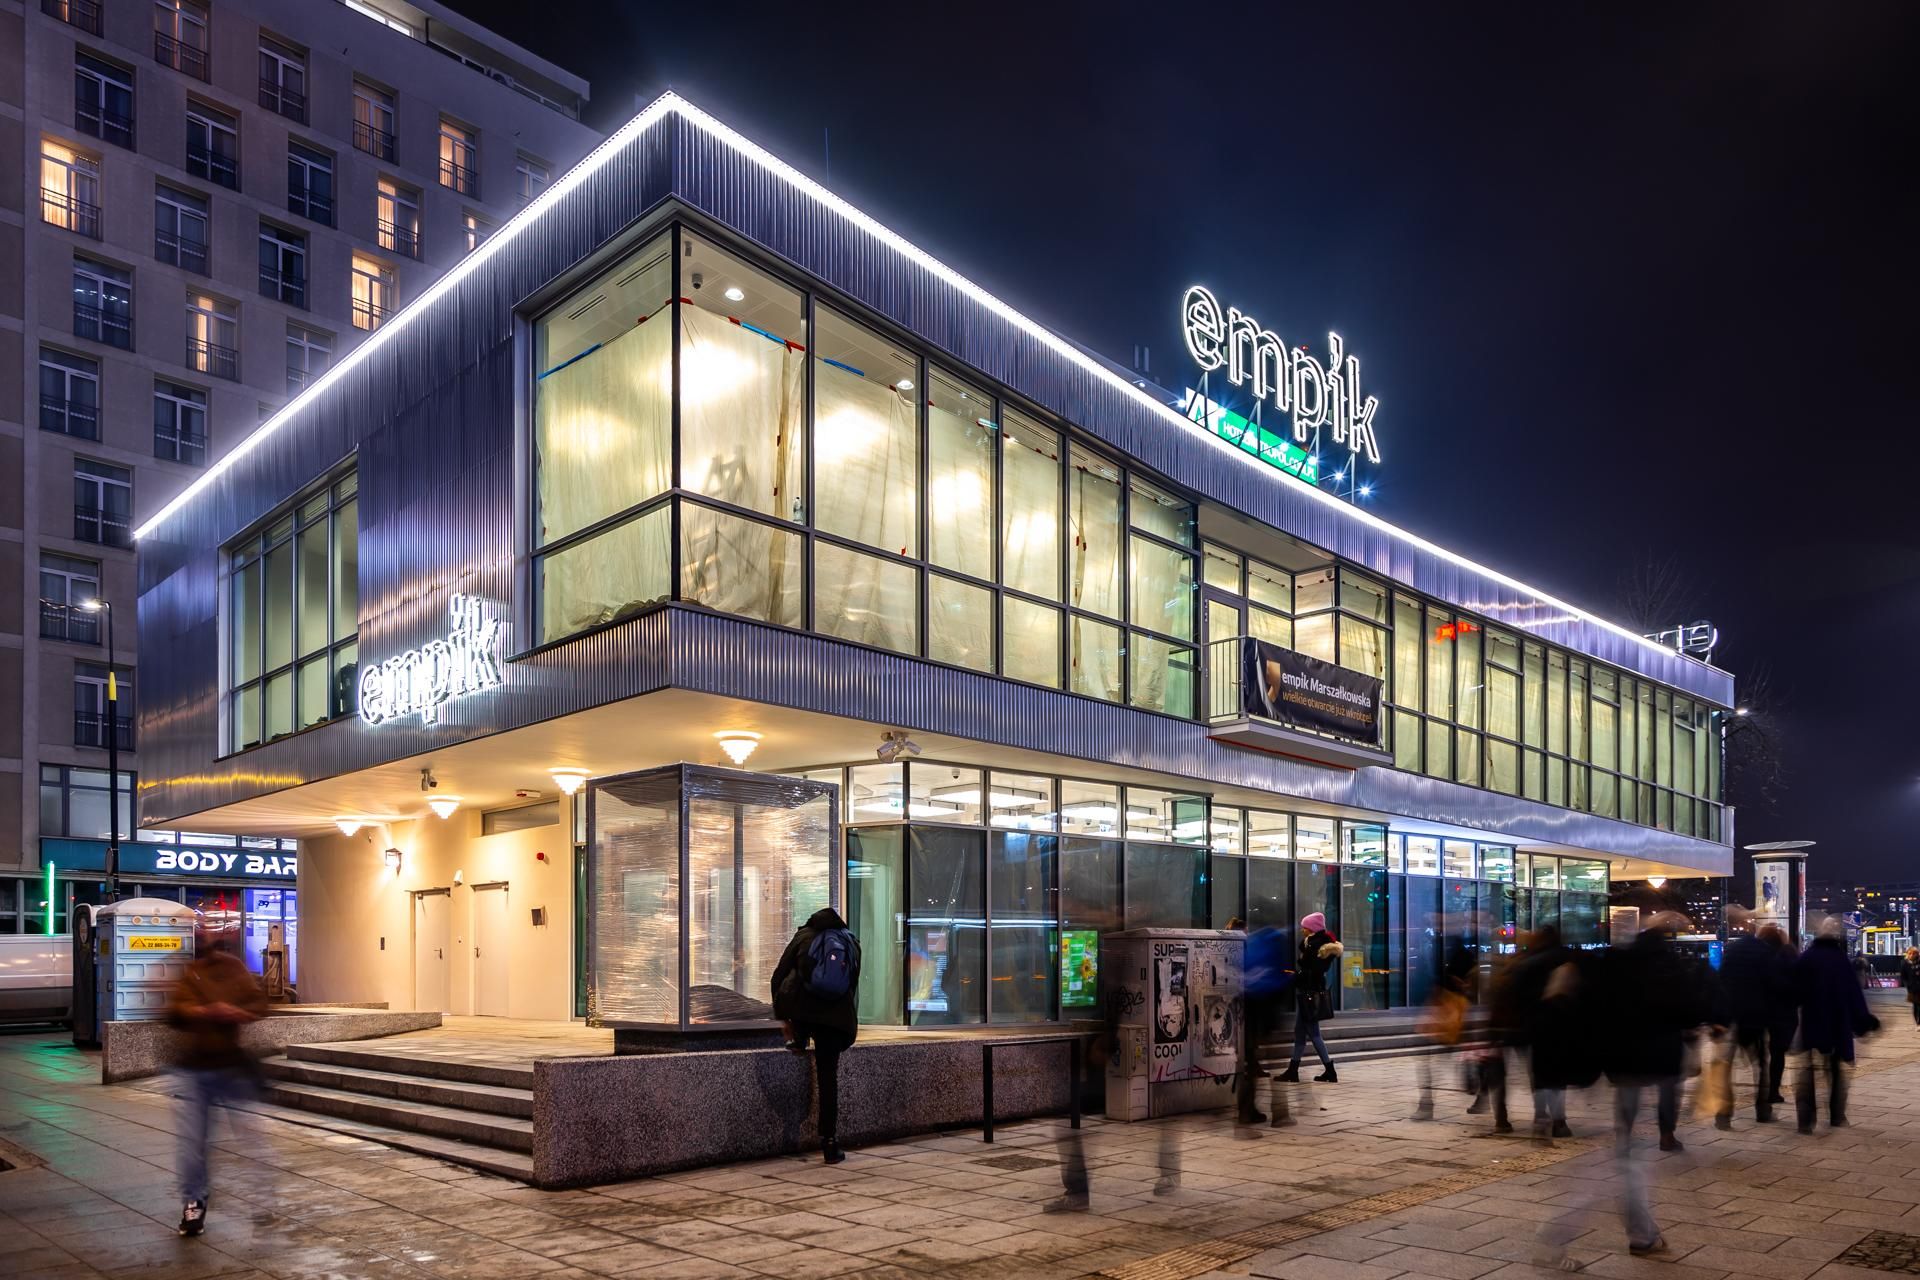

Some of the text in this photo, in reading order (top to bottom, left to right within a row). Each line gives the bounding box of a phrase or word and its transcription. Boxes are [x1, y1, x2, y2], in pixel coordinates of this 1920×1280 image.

[1182, 284, 1381, 464] empik
[358, 593, 503, 725] empik
[1281, 672, 1371, 708] empik Marszałkowska
[1282, 690, 1307, 705] wielkie
[1307, 698, 1335, 714] otwarcie
[1335, 703, 1346, 717] już
[156, 849, 297, 875] BODY BAR
[1153, 943, 1186, 957] SUP
